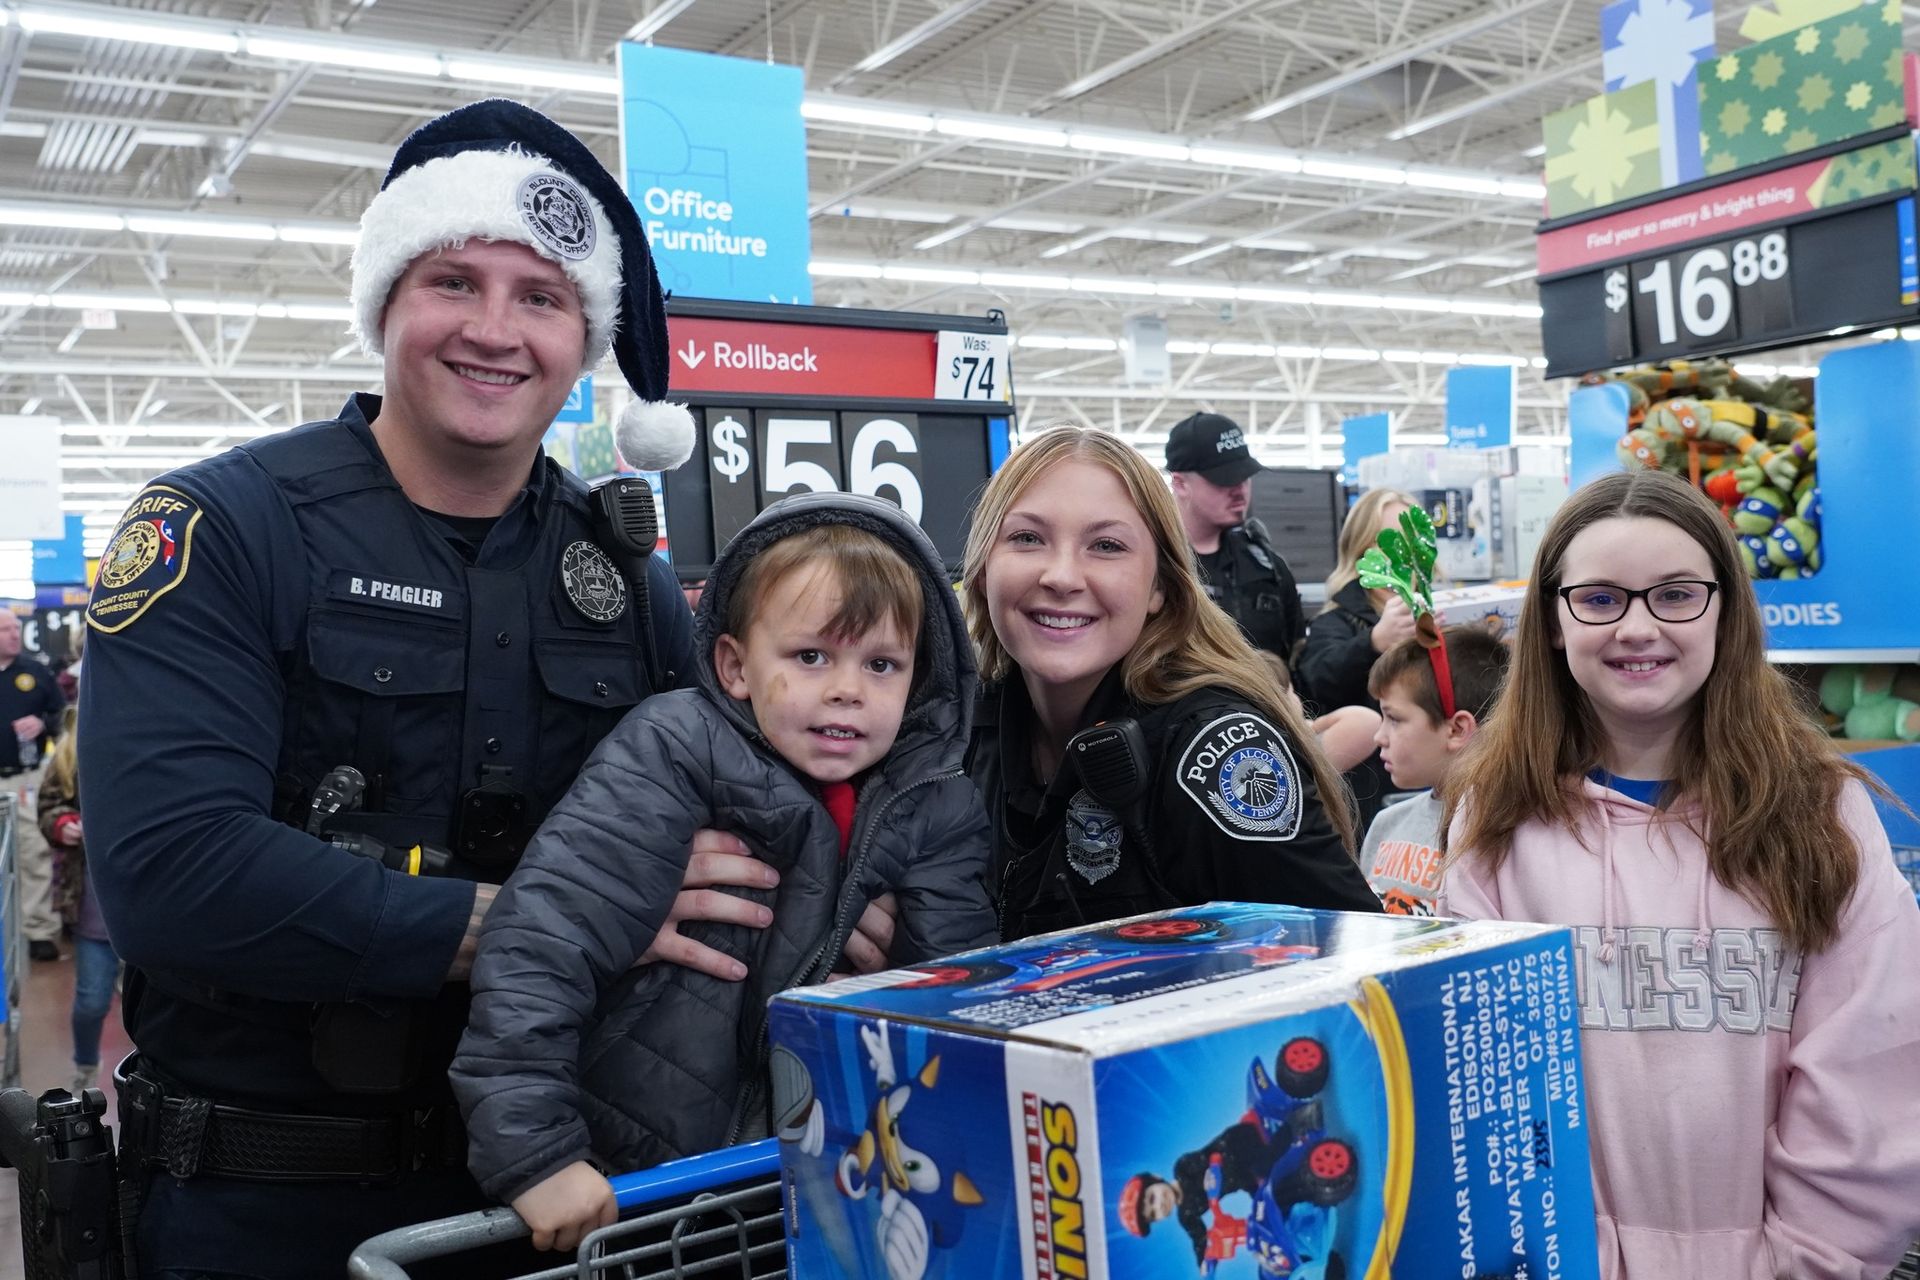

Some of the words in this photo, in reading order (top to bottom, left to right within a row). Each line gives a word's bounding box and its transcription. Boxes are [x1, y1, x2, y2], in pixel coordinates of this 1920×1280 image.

[529, 178, 565, 191] BLOUNT
[569, 189, 593, 231] COUNTY
[644, 187, 733, 221] Office
[1587, 233, 1612, 249] Find
[1614, 226, 1641, 245] your
[1643, 221, 1658, 234] so
[1659, 212, 1698, 231] merry
[1700, 206, 1712, 221] &
[1713, 195, 1755, 218] bright
[1757, 186, 1795, 206] thing
[646, 220, 768, 257] Furniture
[713, 341, 818, 372] Rollback
[962, 336, 990, 351] Was:
[951, 356, 995, 399] $74
[126, 555, 154, 582] OFFICE
[91, 594, 118, 610] BLOUNT
[118, 589, 150, 602] COUNTY
[96, 600, 139, 616] TENNESSEE
[350, 577, 367, 596] B.
[370, 580, 443, 609] PEAGLER
[1761, 602, 1842, 626] DDIES
[1087, 734, 1118, 747] MOTOROLA
[1187, 721, 1260, 784] POLICE
[1240, 750, 1275, 767] ALCOA
[1224, 758, 1237, 773] OF
[1221, 777, 1235, 802] CITY
[1251, 786, 1287, 818] TENNESSEE
[1457, 971, 1473, 1003] NJ
[1507, 958, 1523, 1005] 1PC
[1523, 953, 1541, 1022] 35275
[1555, 945, 1572, 1021] CHINA
[1473, 968, 1498, 1114] PO23000361
[1512, 1011, 1529, 1072] QTY:
[1529, 1030, 1544, 1062] OF
[1539, 950, 1563, 1102] MID#6590723
[1561, 1028, 1574, 1052] IN
[1440, 973, 1469, 1183] INTERNATIONAL
[1461, 1015, 1482, 1121] EDISON,
[1491, 963, 1527, 1256] A6VATV211-BLRD-STK-1
[1563, 1058, 1581, 1129] MADE
[1024, 1098, 1040, 1146] THE
[1516, 1076, 1537, 1182] MASTER
[1486, 1119, 1503, 1186] PO#.:
[1041, 1097, 1090, 1280] SONI
[1541, 1175, 1557, 1228] NO.:
[1030, 1160, 1052, 1280] HEDGEH
[1455, 1187, 1477, 1280] SAKAR
